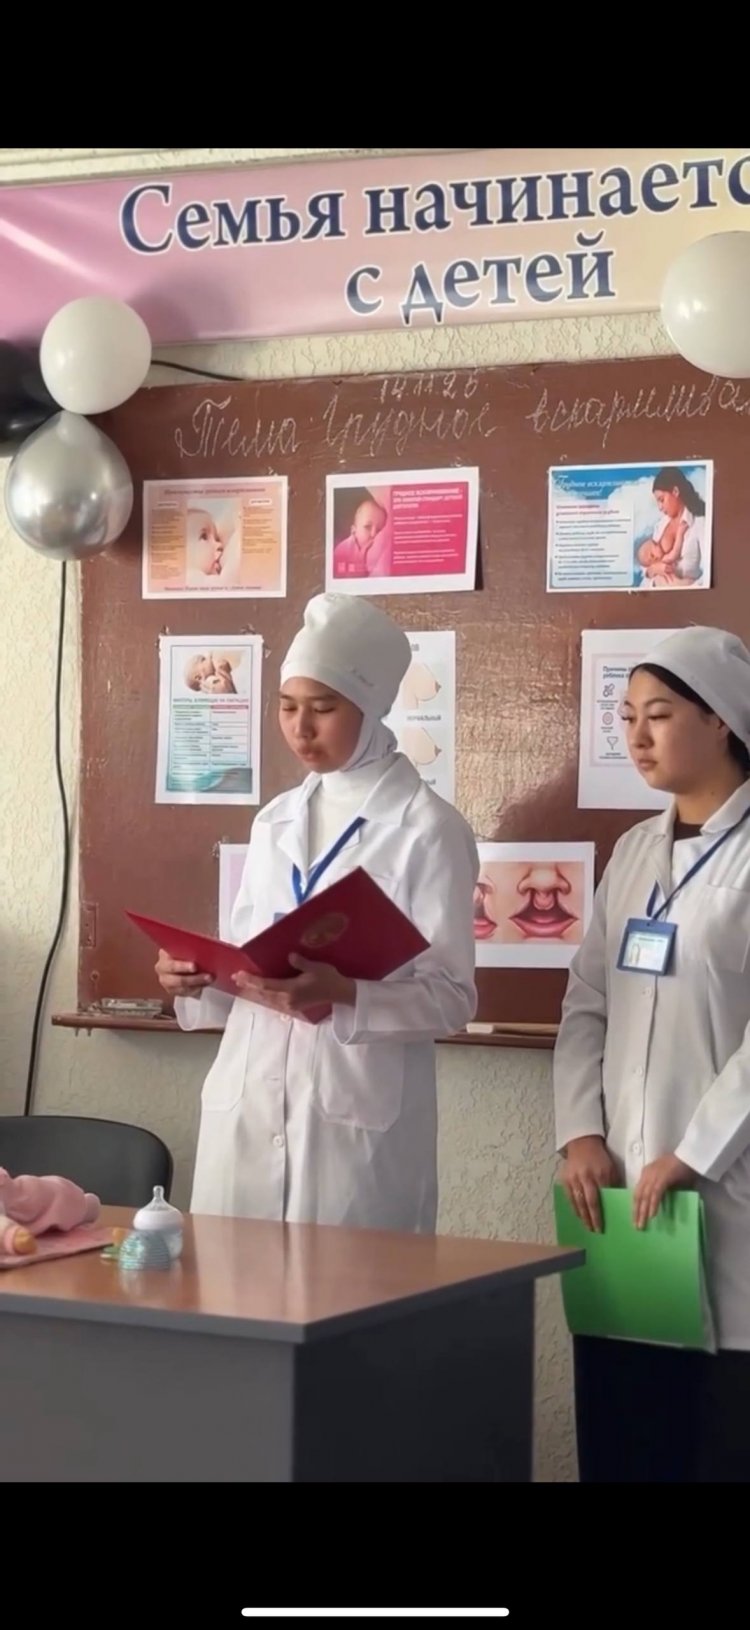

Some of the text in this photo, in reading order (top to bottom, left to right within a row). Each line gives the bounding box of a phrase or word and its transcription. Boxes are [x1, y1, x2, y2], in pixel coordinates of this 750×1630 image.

[121, 155, 750, 253] Семья начинаетс
[345, 230, 616, 325] с детей
